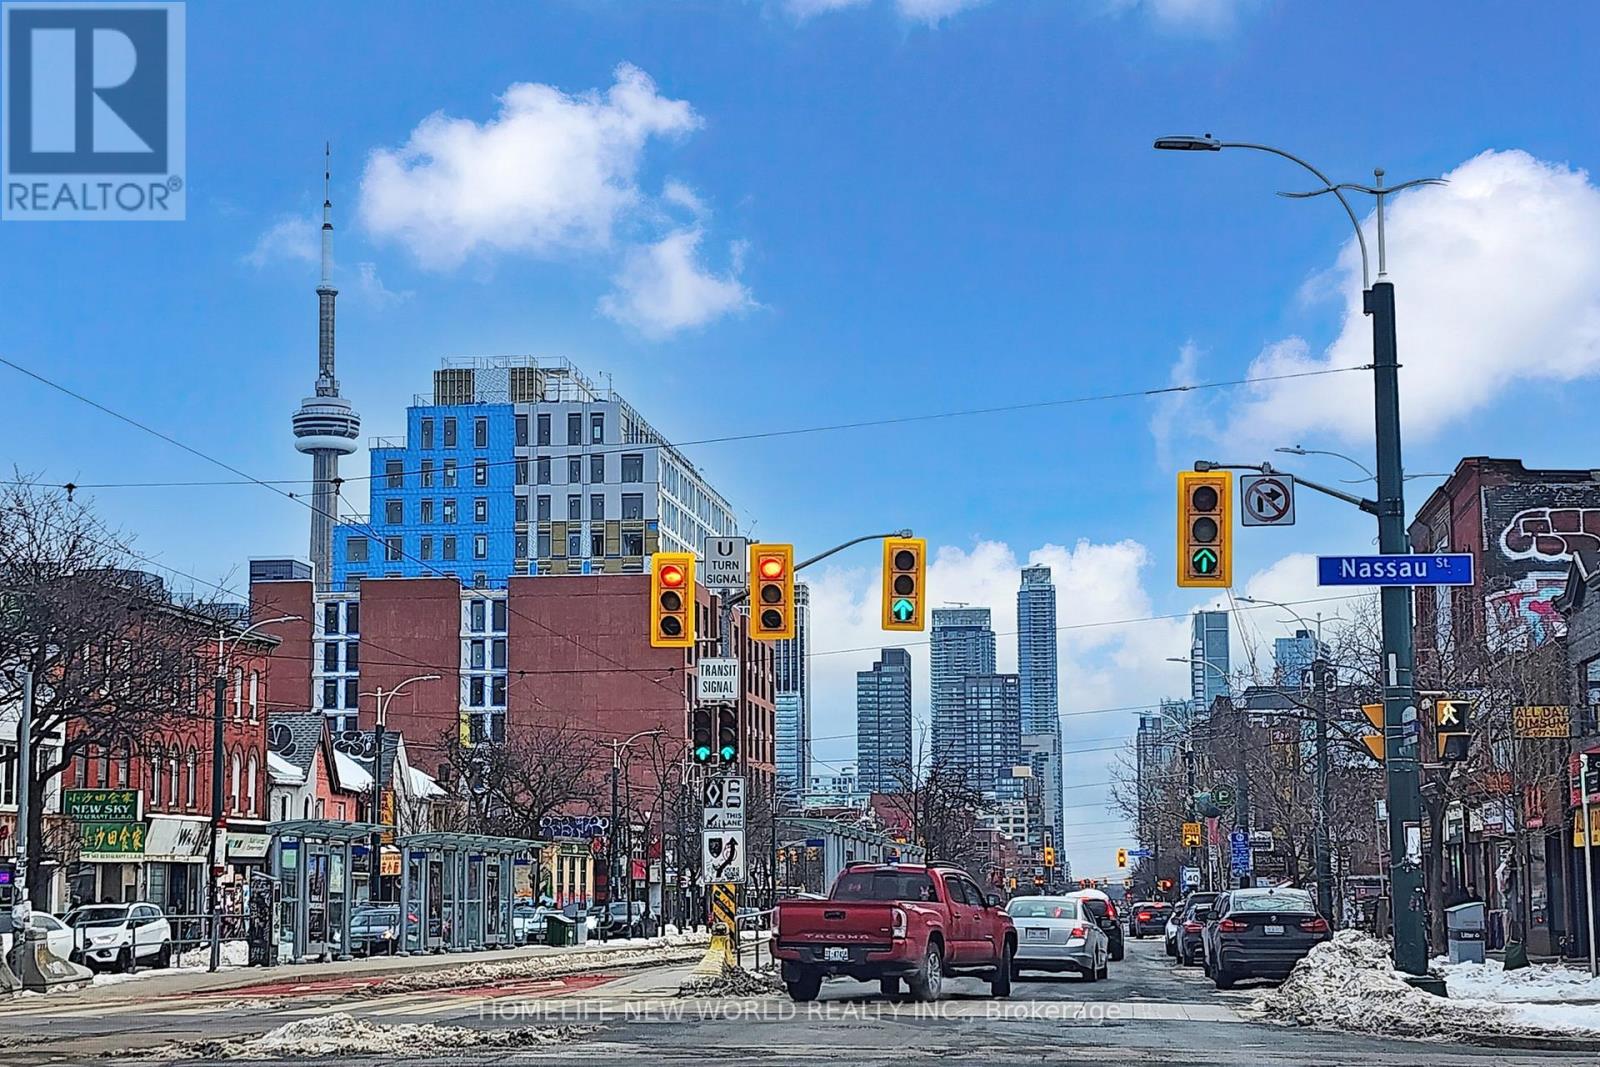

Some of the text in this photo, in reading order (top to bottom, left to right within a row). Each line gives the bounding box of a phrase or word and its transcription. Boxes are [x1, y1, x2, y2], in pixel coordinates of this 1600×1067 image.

[717, 541, 733, 557] U
[712, 560, 739, 570] TURN
[1341, 558, 1427, 577] Nassau
[706, 574, 744, 584] SIGNAL
[700, 664, 737, 677] TRANSIT
[702, 681, 734, 693] SIGNAL
[1515, 707, 1568, 718] ALL DAY
[1219, 790, 1229, 801] P
[71, 804, 131, 814] NEW SKY
[723, 819, 742, 827] LANE
[1184, 835, 1199, 846] 24
[1187, 874, 1199, 883] 40
